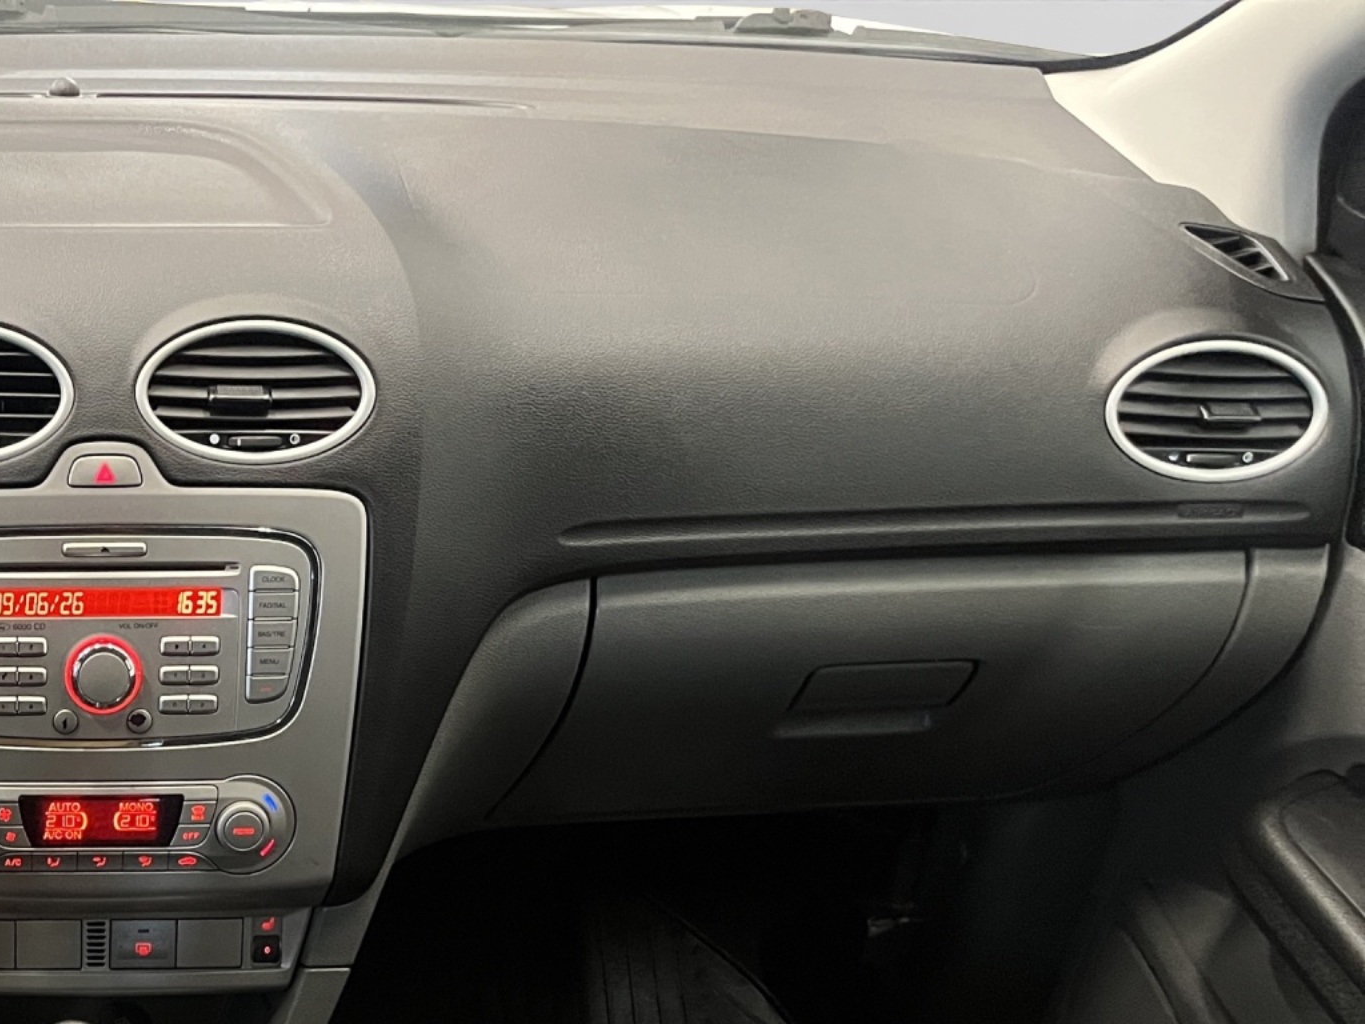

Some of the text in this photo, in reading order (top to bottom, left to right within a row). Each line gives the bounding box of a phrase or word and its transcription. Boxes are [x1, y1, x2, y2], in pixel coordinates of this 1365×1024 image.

[48, 802, 81, 812] AUTO
[118, 802, 155, 812] MONO
[42, 830, 82, 840] A/C ON
[182, 831, 201, 841] OFF
[4, 858, 22, 866] A/C
